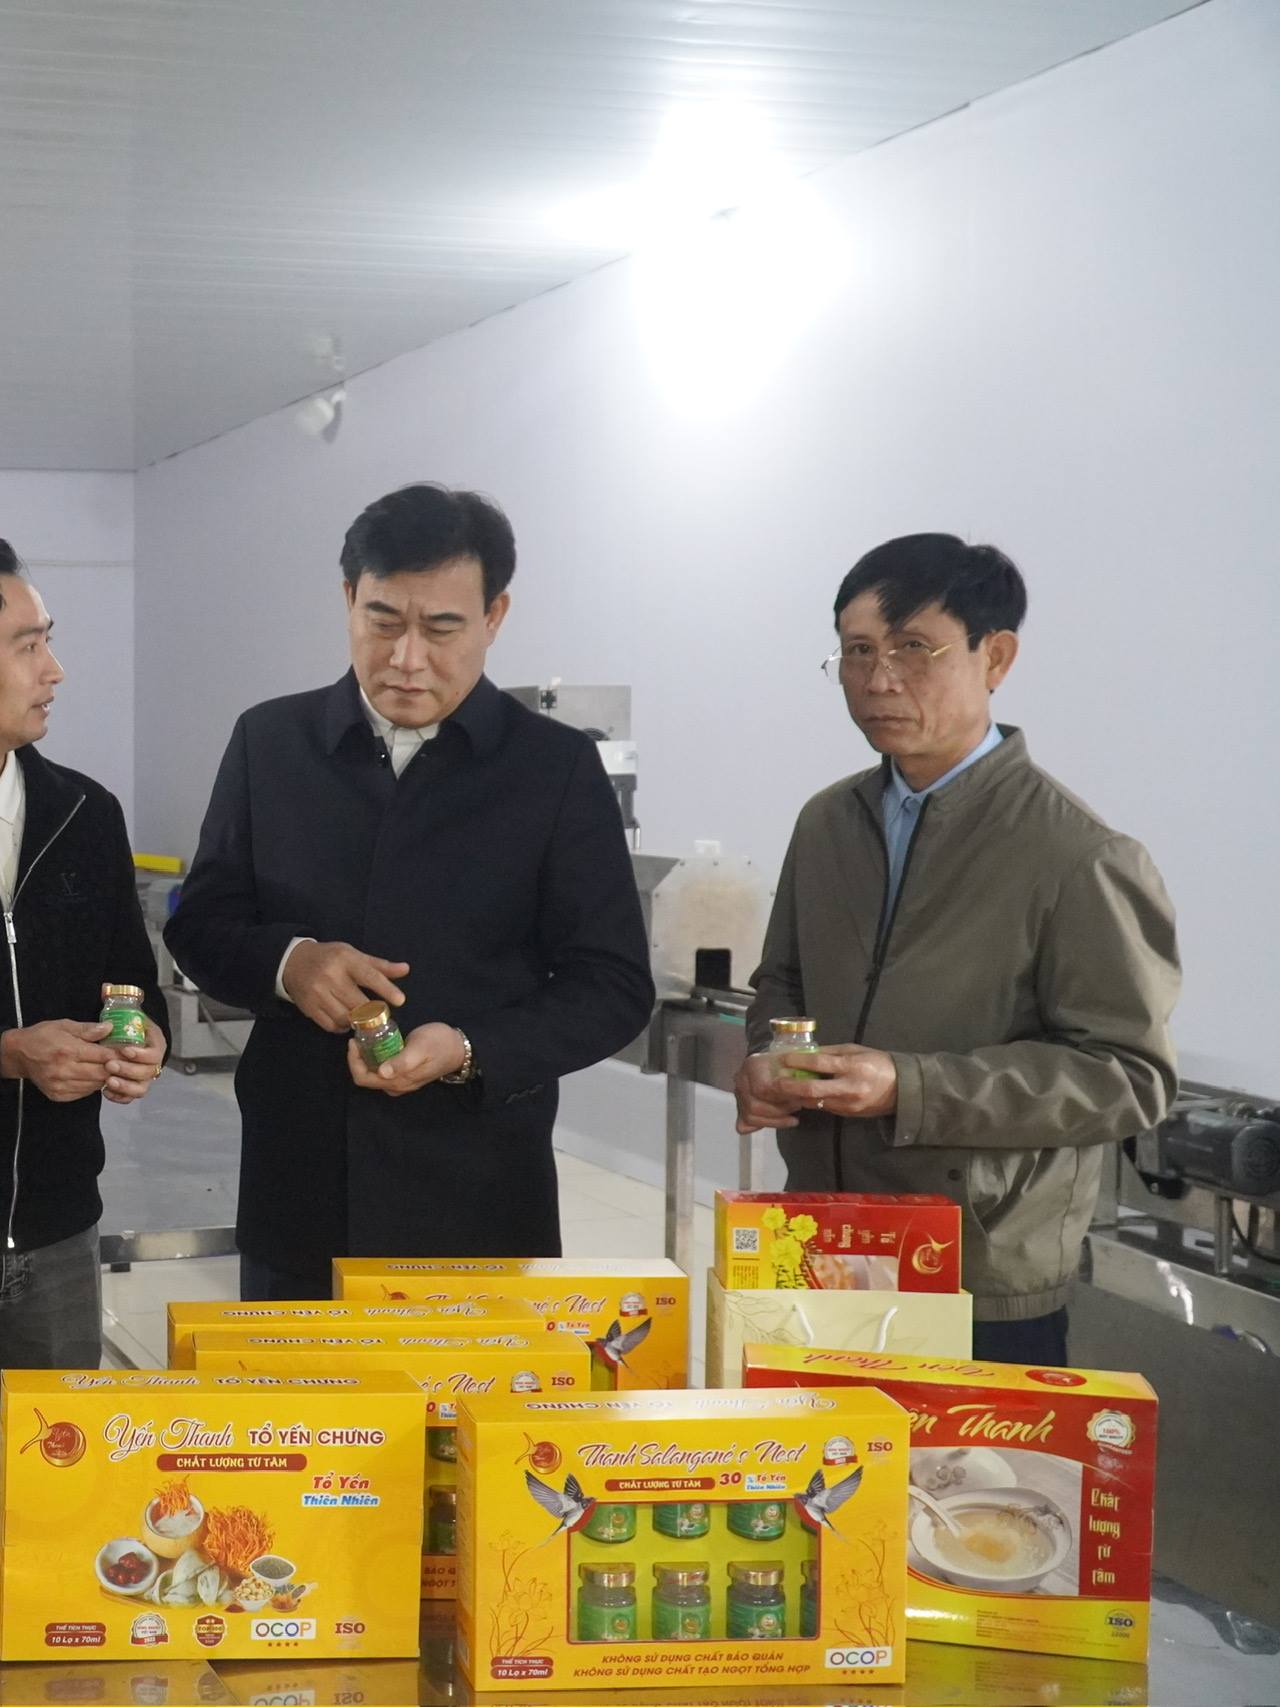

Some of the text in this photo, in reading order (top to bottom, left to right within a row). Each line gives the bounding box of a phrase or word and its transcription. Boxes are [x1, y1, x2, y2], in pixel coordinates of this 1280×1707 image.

[655, 1297, 677, 1306] ISO
[448, 1372, 496, 1393] Nest
[551, 1377, 575, 1386] ISO
[946, 1404, 1056, 1444] Thanh
[103, 1412, 157, 1462] Yến
[160, 1417, 235, 1450] Thanh
[248, 1421, 273, 1446] TỔ
[278, 1423, 312, 1446] YẾN
[317, 1427, 386, 1446] CHƯNG
[867, 1441, 893, 1452] ISO
[577, 1441, 639, 1467] Thanh
[753, 1440, 807, 1464] Nest
[313, 1472, 370, 1490] Tổ Yến
[720, 1472, 742, 1485] 30
[302, 1495, 379, 1507] Thiên Nhiên
[1108, 1616, 1134, 1627] ISO
[255, 1622, 312, 1638] OCOP
[335, 1622, 366, 1634] ISO
[52, 1636, 61, 1644] 10
[81, 1635, 101, 1644] 70ml
[602, 1653, 642, 1664] KHÔNG
[829, 1650, 888, 1666] OCOP
[498, 1669, 507, 1677] 10
[573, 1667, 614, 1678] KHÔNG
